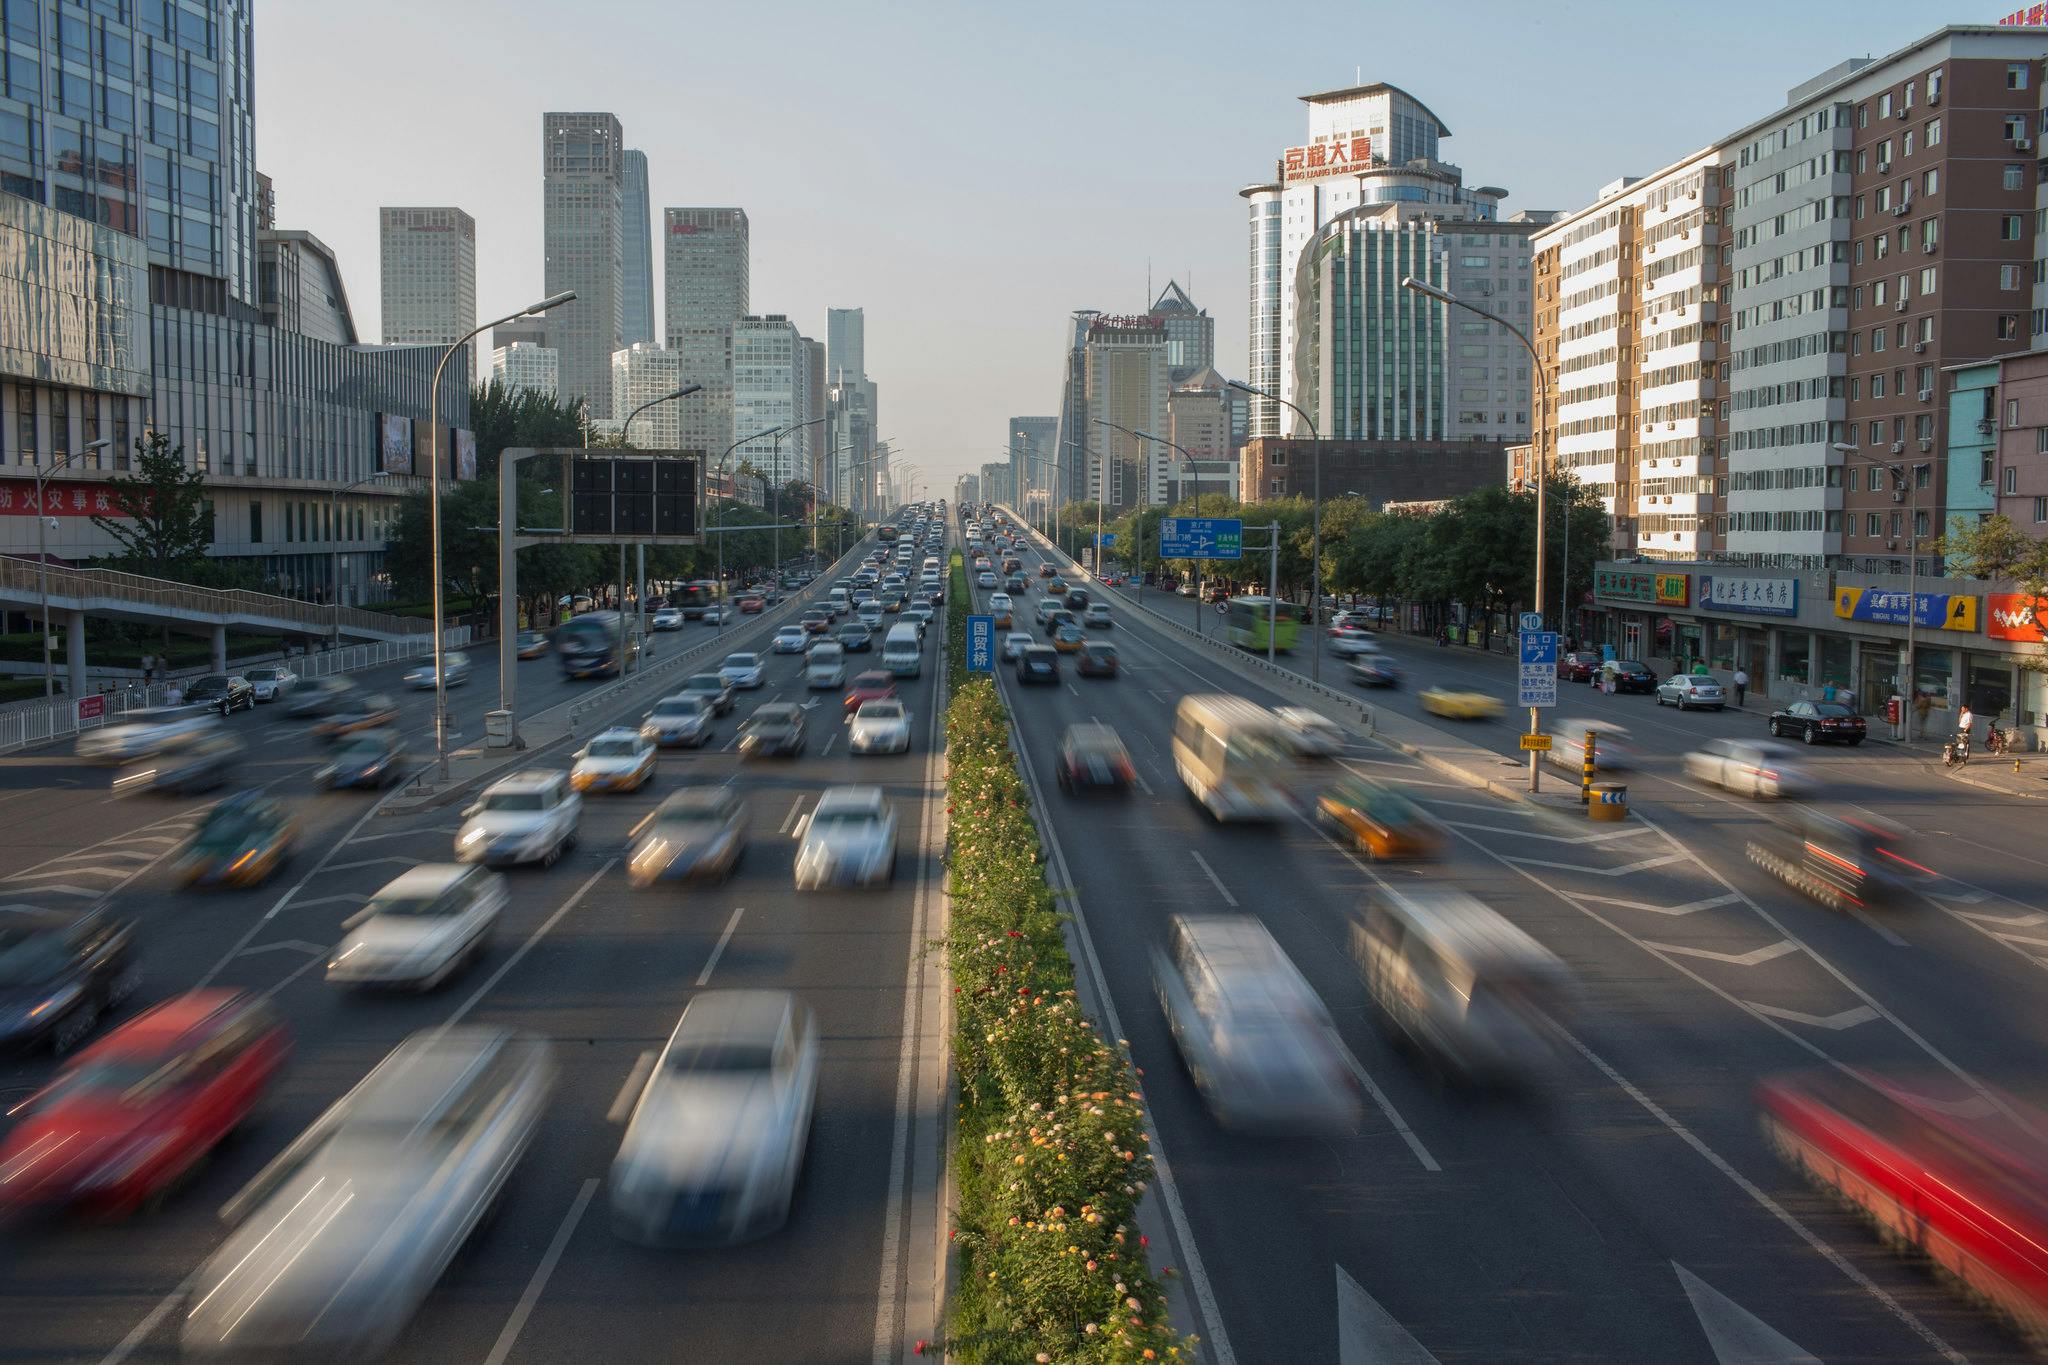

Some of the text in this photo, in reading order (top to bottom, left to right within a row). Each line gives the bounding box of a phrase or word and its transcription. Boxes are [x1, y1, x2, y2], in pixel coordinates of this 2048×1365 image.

[1287, 163, 1370, 181] JING LIANG BUILDING
[1525, 616, 1537, 628] 10
[973, 621, 988, 667] 国贸桥
[1528, 635, 1550, 644] 出口
